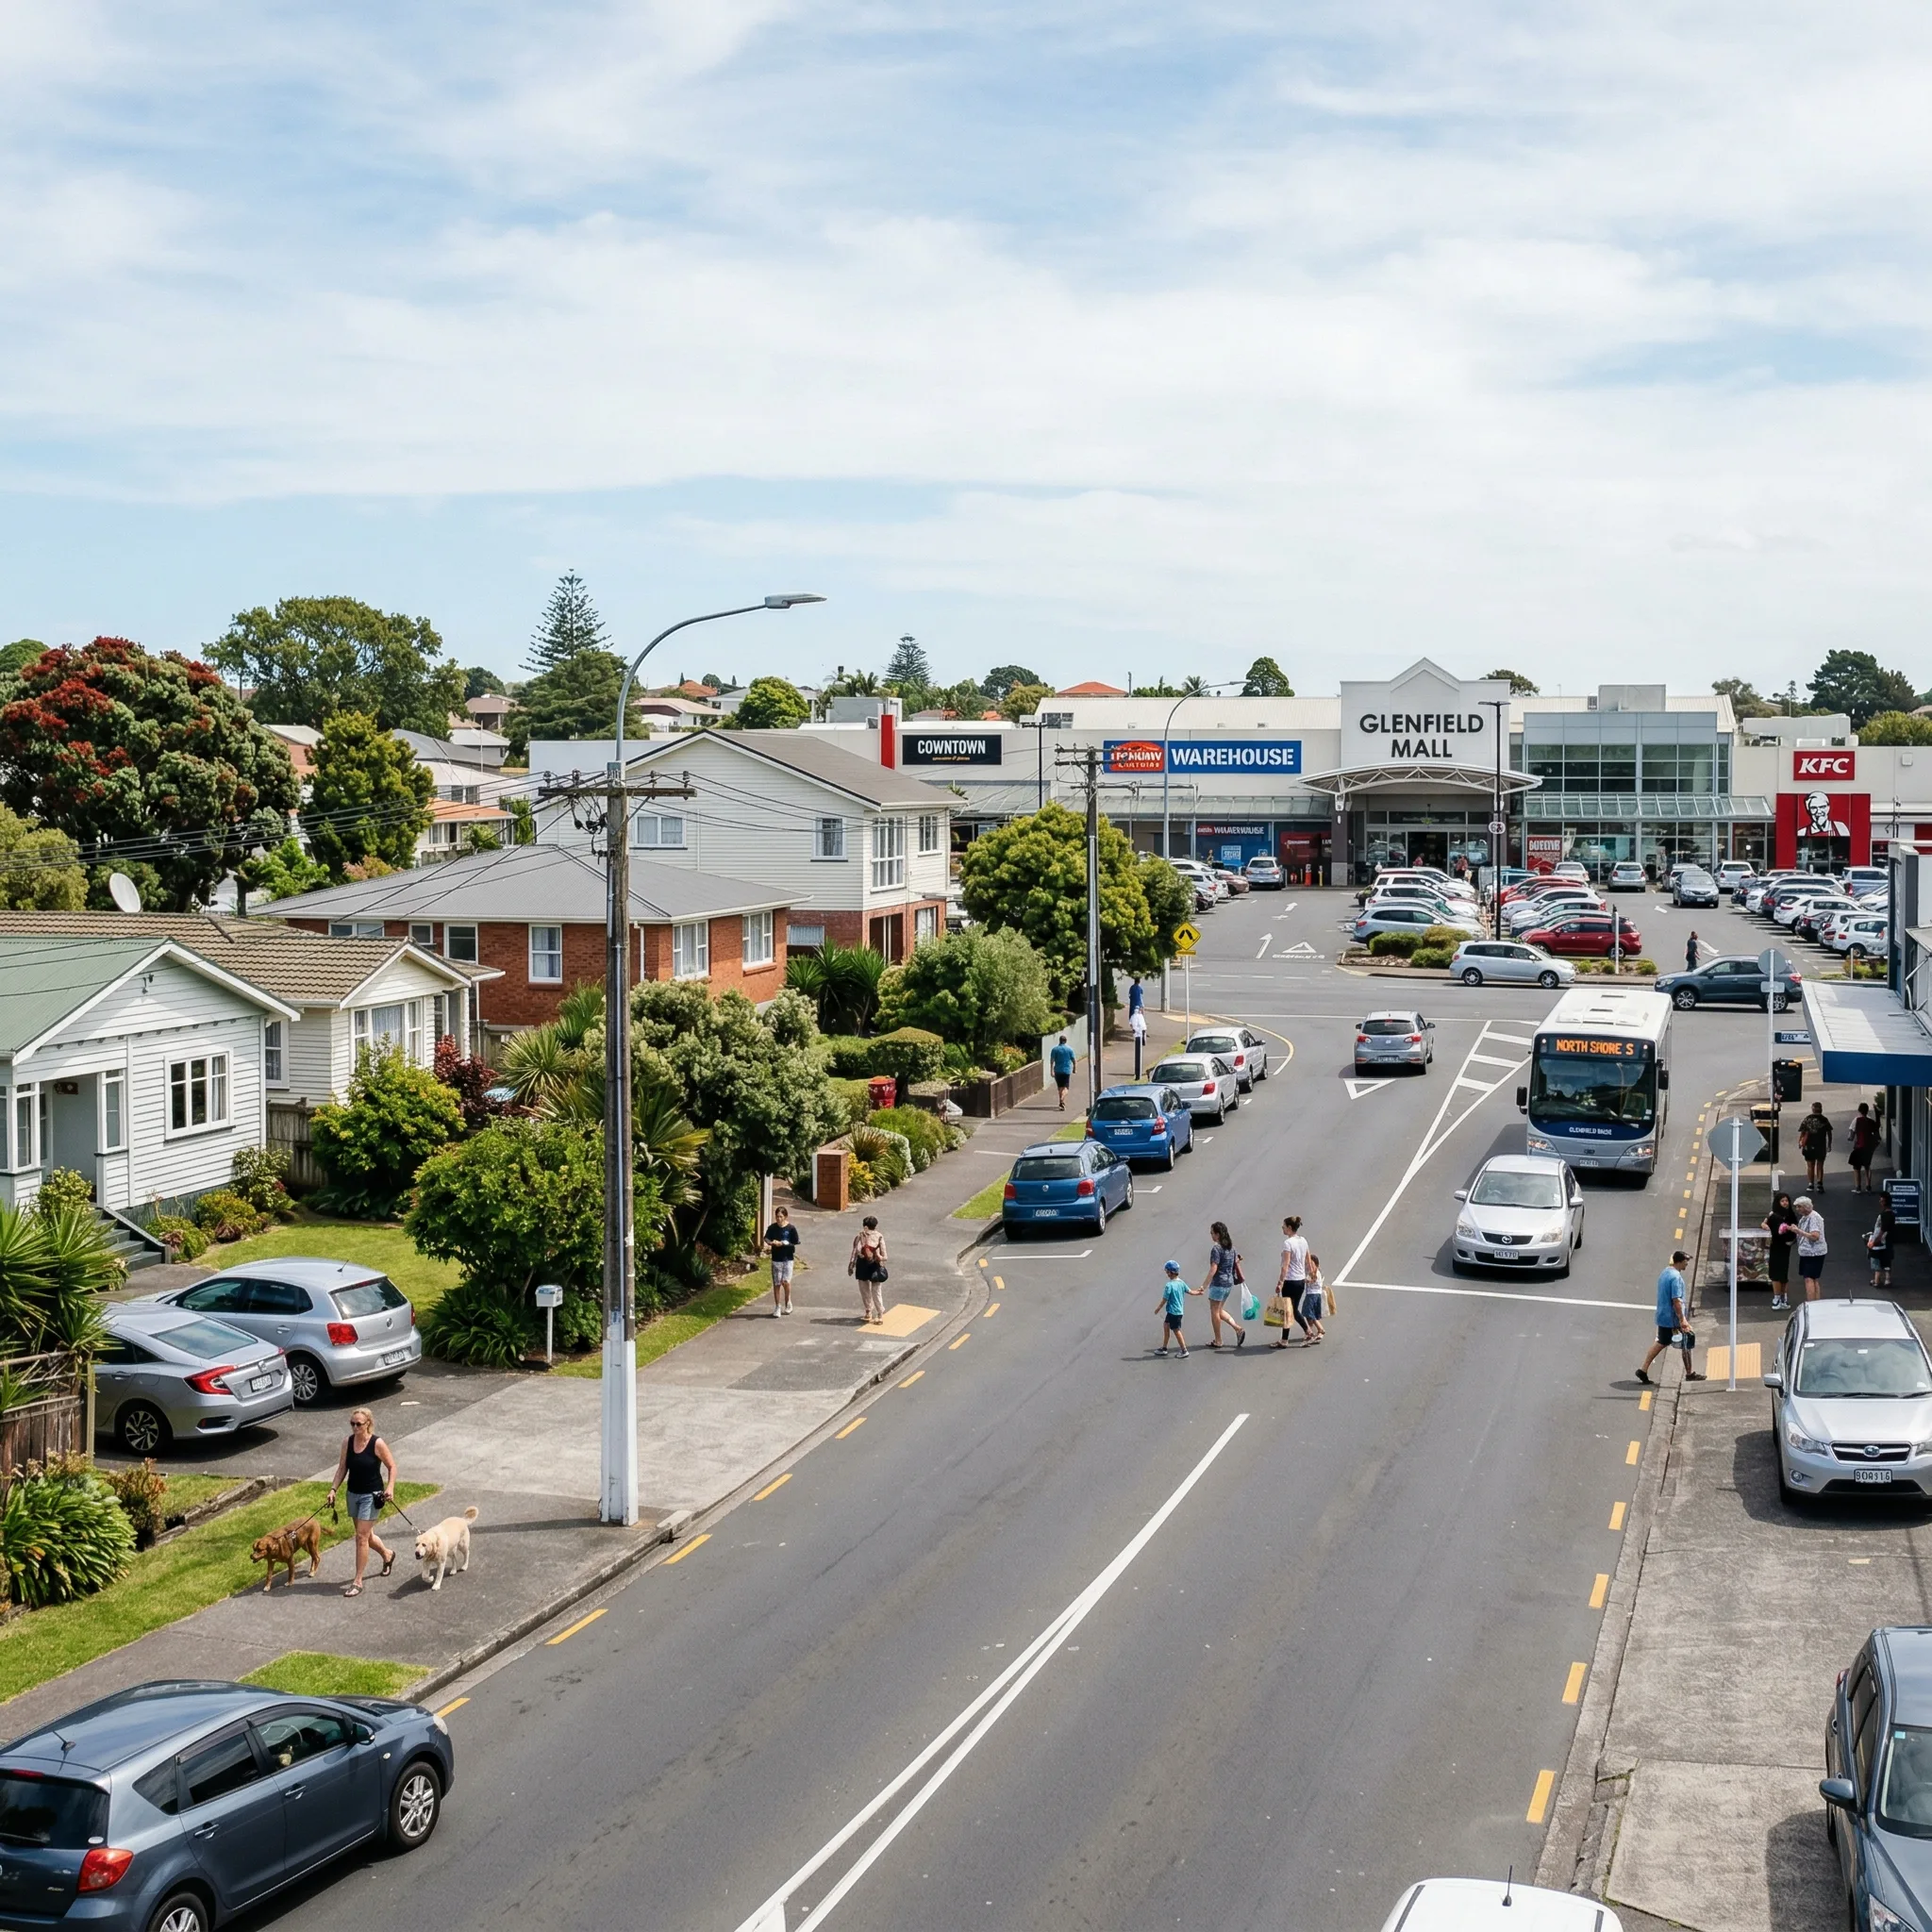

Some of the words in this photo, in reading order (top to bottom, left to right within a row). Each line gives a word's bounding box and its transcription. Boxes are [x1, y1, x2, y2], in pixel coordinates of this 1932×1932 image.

[1359, 713, 1484, 734] GLENFIELD
[917, 740, 986, 755] COWNTOWN
[1391, 739, 1452, 758] MALL
[1171, 748, 1294, 766] WAREHOUSE
[1798, 758, 1850, 774] KFC
[1556, 1039, 1588, 1053] NORTH
[1625, 1042, 1634, 1056] S
